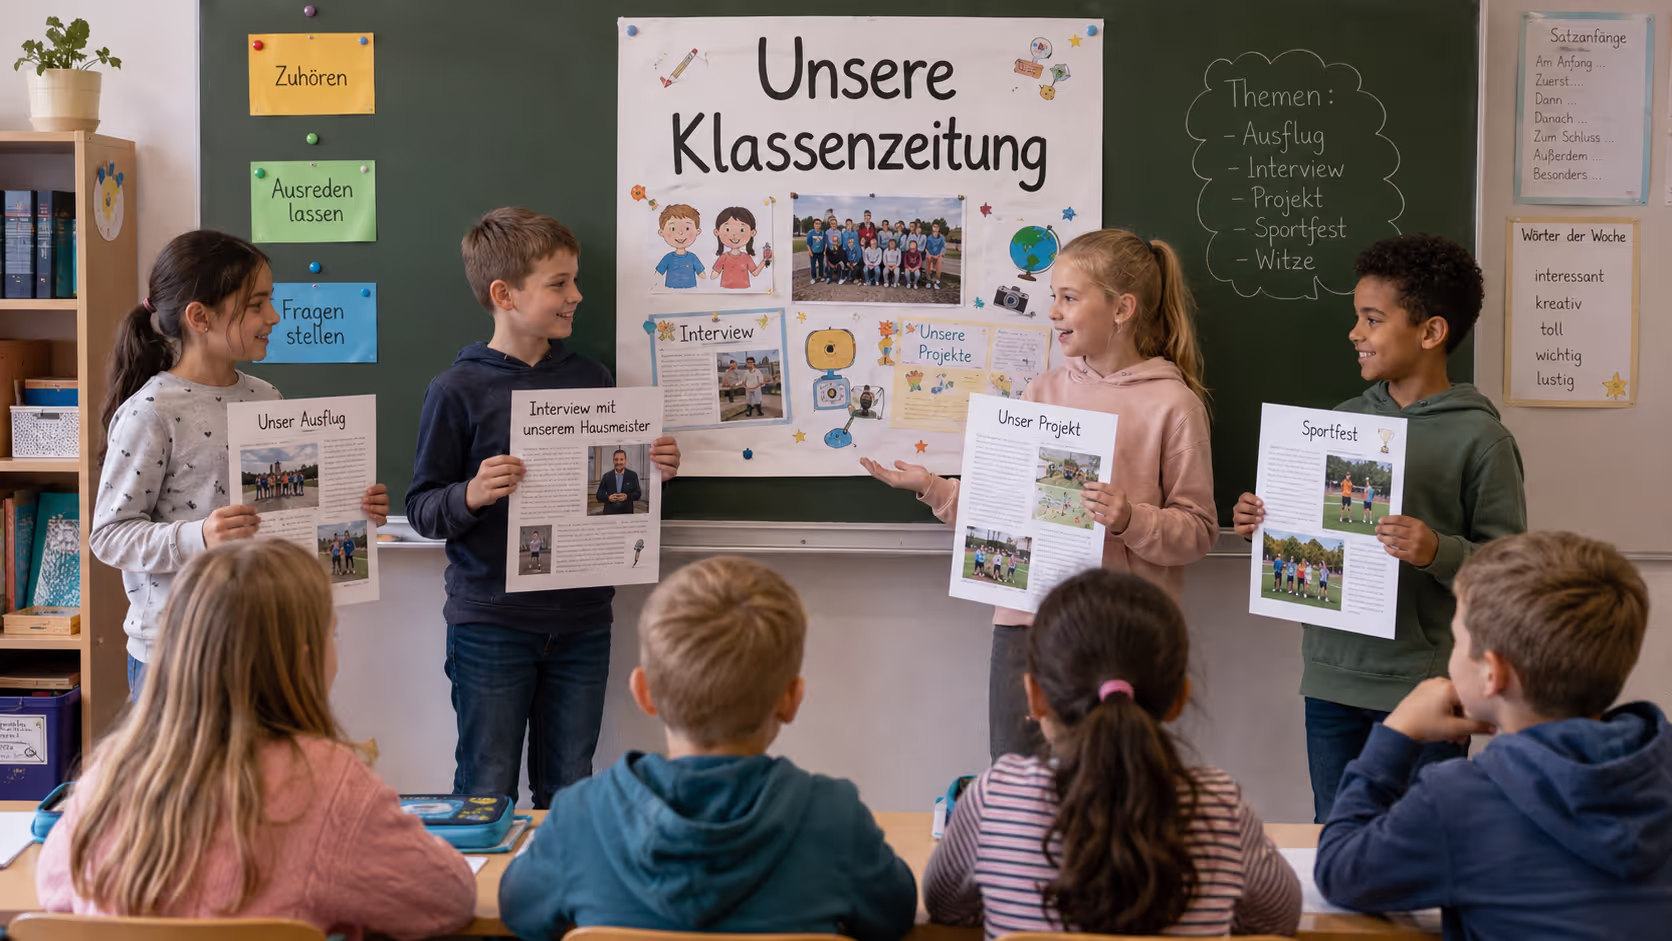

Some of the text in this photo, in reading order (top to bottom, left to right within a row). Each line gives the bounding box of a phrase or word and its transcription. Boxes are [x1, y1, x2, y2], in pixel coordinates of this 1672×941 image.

[1551, 28, 1626, 49] Satzanfänge
[758, 36, 956, 100] Unsere
[1536, 55, 1552, 67] Am
[276, 65, 347, 86] Zuhören
[1536, 92, 1562, 104] Dann
[1535, 111, 1573, 124] Danach
[1243, 120, 1325, 155] Ausflug
[1534, 130, 1556, 142] Zum
[1563, 130, 1600, 142] Schluss
[673, 112, 1047, 192] Klassenzeitung
[1533, 149, 1587, 164] Außerdem
[1248, 156, 1345, 179] Interview
[1534, 167, 1587, 180] Besonders
[272, 178, 353, 198] Ausreden
[1251, 186, 1323, 216] Projekt
[289, 203, 343, 222] lassen
[1255, 216, 1347, 247] Sportfest
[1522, 228, 1625, 242] Wörter der Woche
[1256, 248, 1315, 270] Witze
[1535, 268, 1604, 283] interessant
[1536, 295, 1581, 309] kreativ
[282, 299, 344, 328] Fragen
[286, 323, 345, 345] stellen
[680, 325, 754, 342] Interview
[921, 324, 965, 341] Unsere
[1541, 322, 1563, 336] toll
[919, 344, 971, 366] Projekte
[1536, 348, 1582, 366] wichtig
[1538, 371, 1574, 391] lustig
[530, 400, 615, 416] Interview mit
[259, 409, 346, 430] Unser Ausflug
[524, 420, 650, 435] unserem Hausmeister
[999, 409, 1080, 438] Unser Projekt
[1302, 420, 1357, 441] Sportfest
